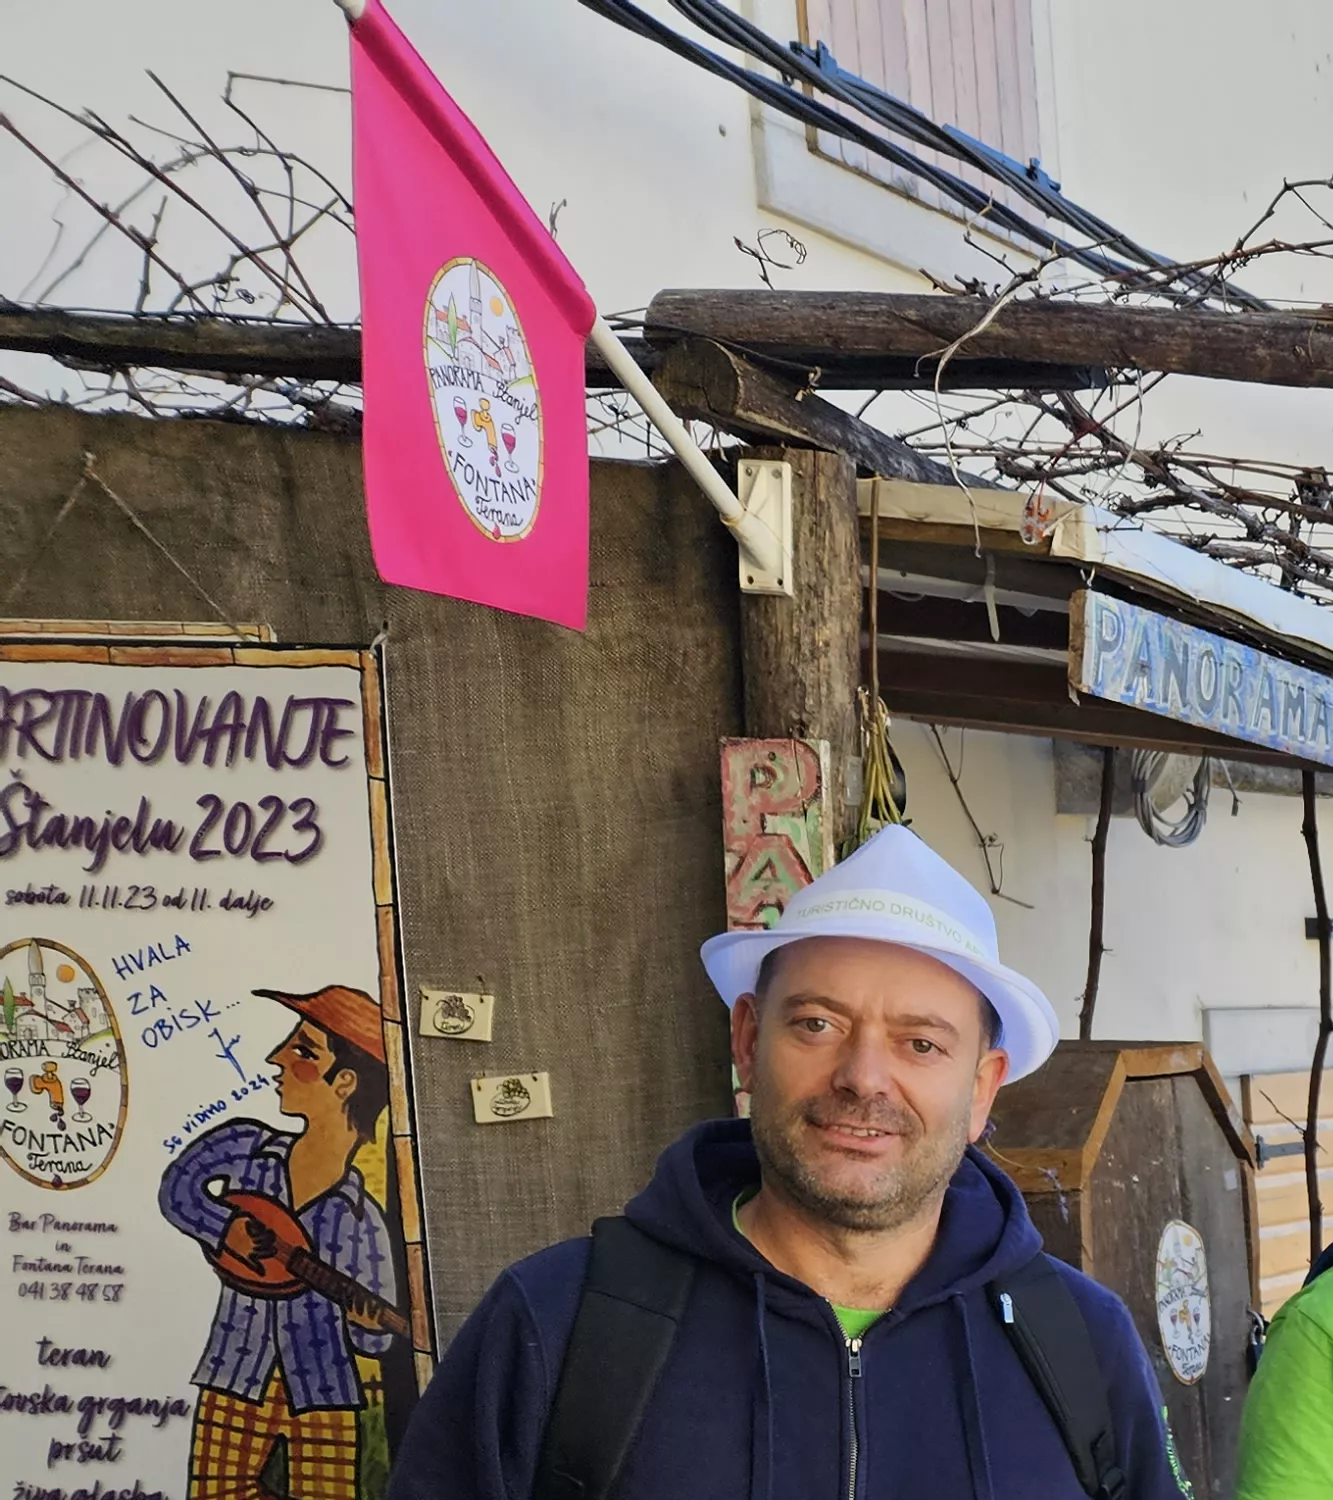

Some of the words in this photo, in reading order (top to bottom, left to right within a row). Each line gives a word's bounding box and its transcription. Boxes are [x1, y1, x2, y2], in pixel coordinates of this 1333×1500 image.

[429, 365, 485, 393] PANORAMA
[1094, 600, 1332, 751] PANORAMA
[189, 794, 323, 864] 2023
[5, 883, 71, 905] sobota
[79, 884, 157, 911] 11.11.23
[161, 887, 188, 909] od
[191, 887, 212, 912] 11.
[218, 888, 275, 919] dalje
[890, 902, 963, 944] DRUŠTVO
[111, 934, 191, 981] HVALA
[127, 984, 168, 1015] ZA
[231, 1073, 270, 1101] 2024
[27, 1151, 93, 1174] Terana
[8, 1211, 36, 1232] Bar
[38, 1213, 119, 1233] Panorama
[55, 1240, 73, 1252] in
[13, 1254, 73, 1273] Fontana
[74, 1256, 125, 1275] Terana
[18, 1281, 45, 1300] 041
[49, 1282, 73, 1301] 38
[102, 1283, 124, 1302] 58
[36, 1336, 111, 1368] teran
[47, 1432, 122, 1469] pršut
